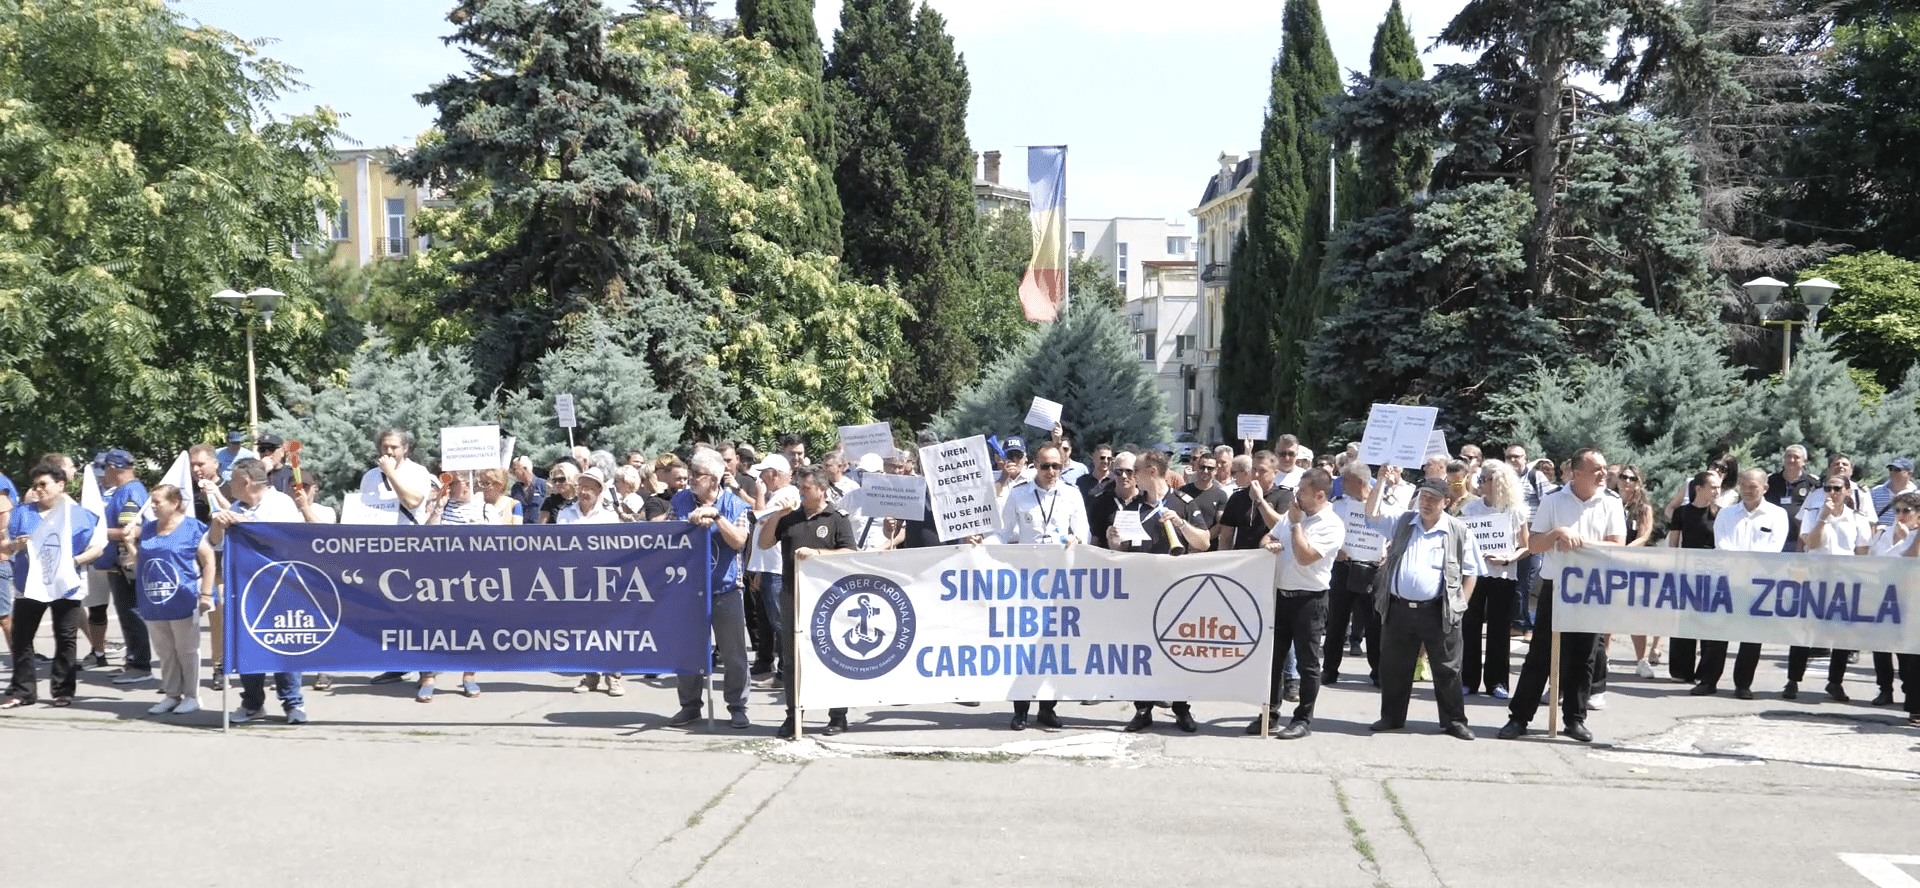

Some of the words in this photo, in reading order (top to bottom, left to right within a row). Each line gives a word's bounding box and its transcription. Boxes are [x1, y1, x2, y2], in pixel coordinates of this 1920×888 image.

[940, 447, 968, 457] VREM
[938, 459, 975, 472] SALARII
[938, 471, 982, 486] DECENTE
[943, 512, 956, 520] NU
[960, 508, 972, 516] SE
[974, 504, 992, 513] MAI
[949, 520, 980, 532] POATE
[312, 536, 464, 554] CONFEDERATIA
[469, 535, 584, 551] NATIONALA
[587, 534, 692, 550] SINDICALA
[379, 568, 514, 602] Cartel
[525, 566, 655, 602] ALFA
[940, 568, 1130, 601] SINDICATUL
[1561, 566, 1733, 614] CAPITANIA
[1750, 578, 1901, 624] ZONALA
[274, 610, 315, 628] alfa
[816, 592, 840, 655] SINDICATUL
[840, 579, 870, 594] LIBER
[874, 580, 911, 624] CARDINAL
[896, 627, 911, 650] ANR
[989, 605, 1081, 638] LIBER
[263, 633, 321, 644] CARTEL
[1178, 616, 1237, 641] alfa
[382, 630, 486, 651] FILIALA
[493, 629, 658, 652] CONSTANTA
[916, 643, 1076, 678] CARDINAL
[1085, 643, 1152, 677] ANR
[1169, 644, 1245, 658] CARTEL
